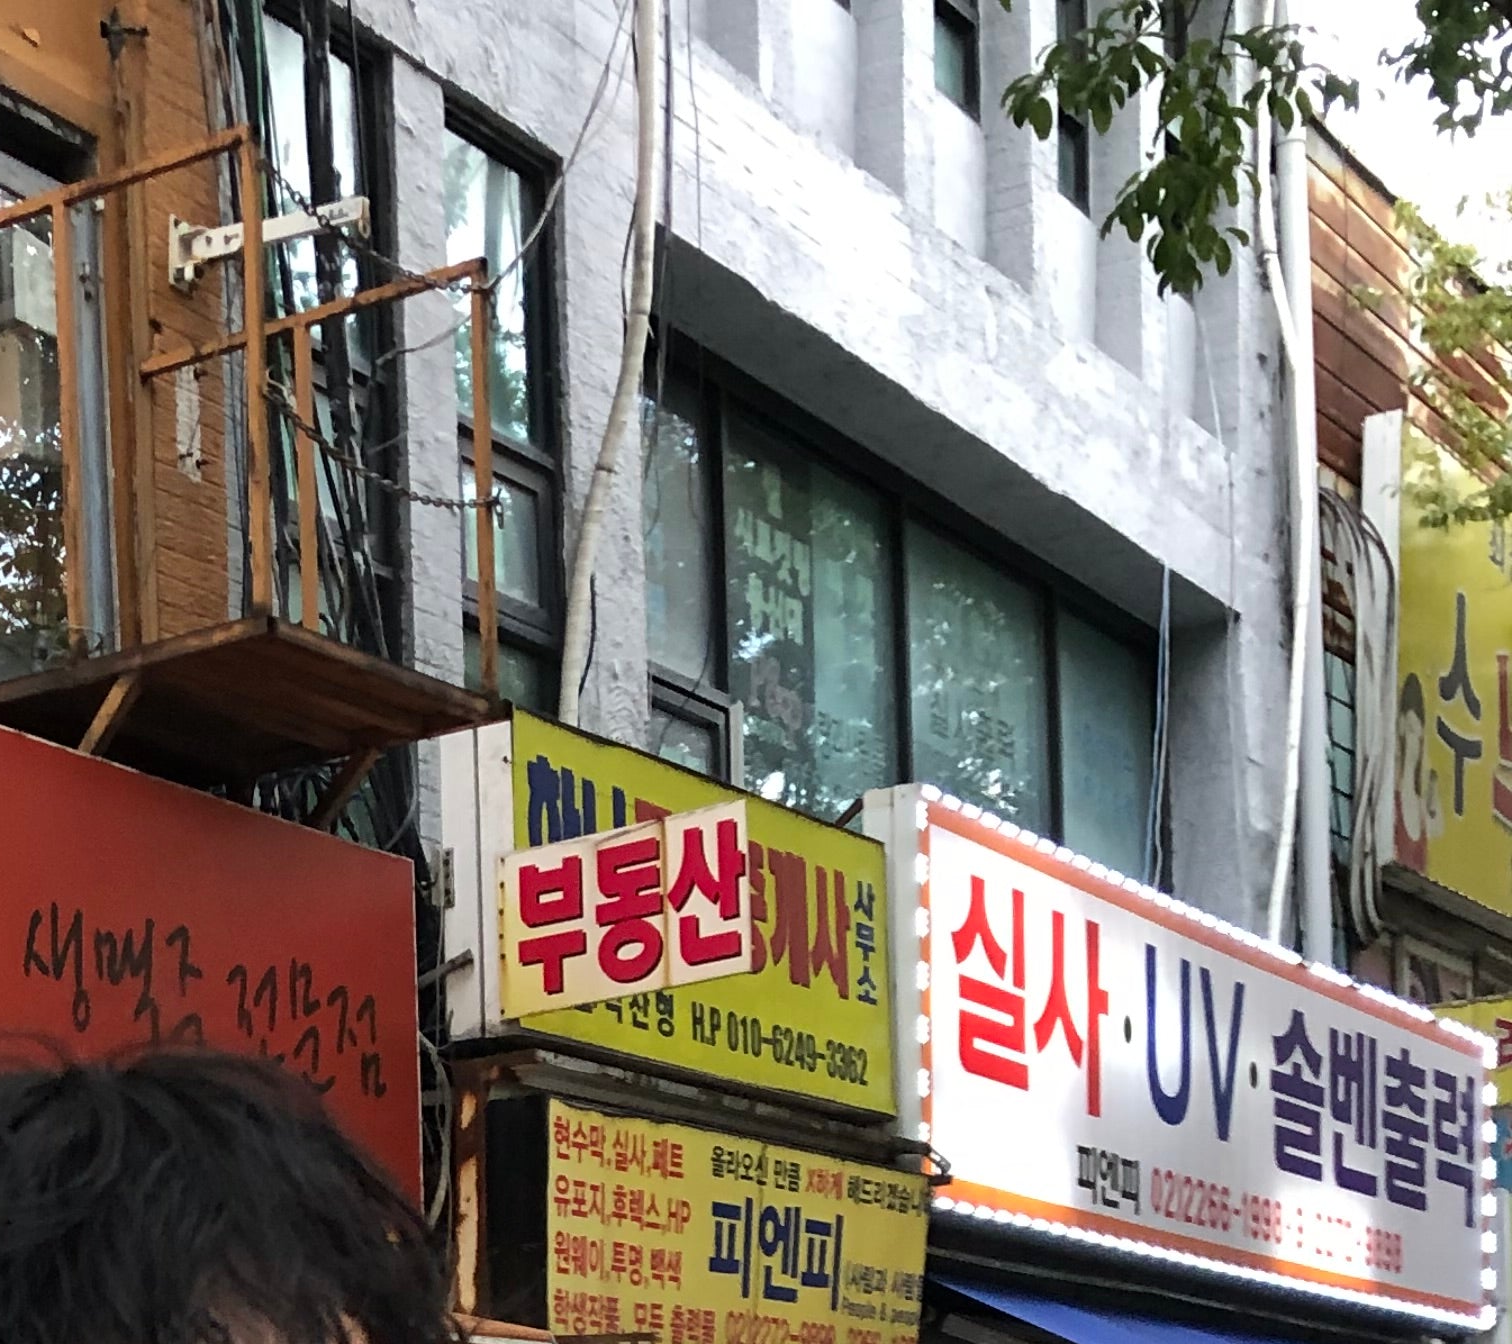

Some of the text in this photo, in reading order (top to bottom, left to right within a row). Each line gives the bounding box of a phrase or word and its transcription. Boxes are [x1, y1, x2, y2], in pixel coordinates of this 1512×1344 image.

[518, 818, 747, 995] 부동산
[854, 880, 878, 1006] 사무소
[708, 1196, 845, 1314] 피엔피
